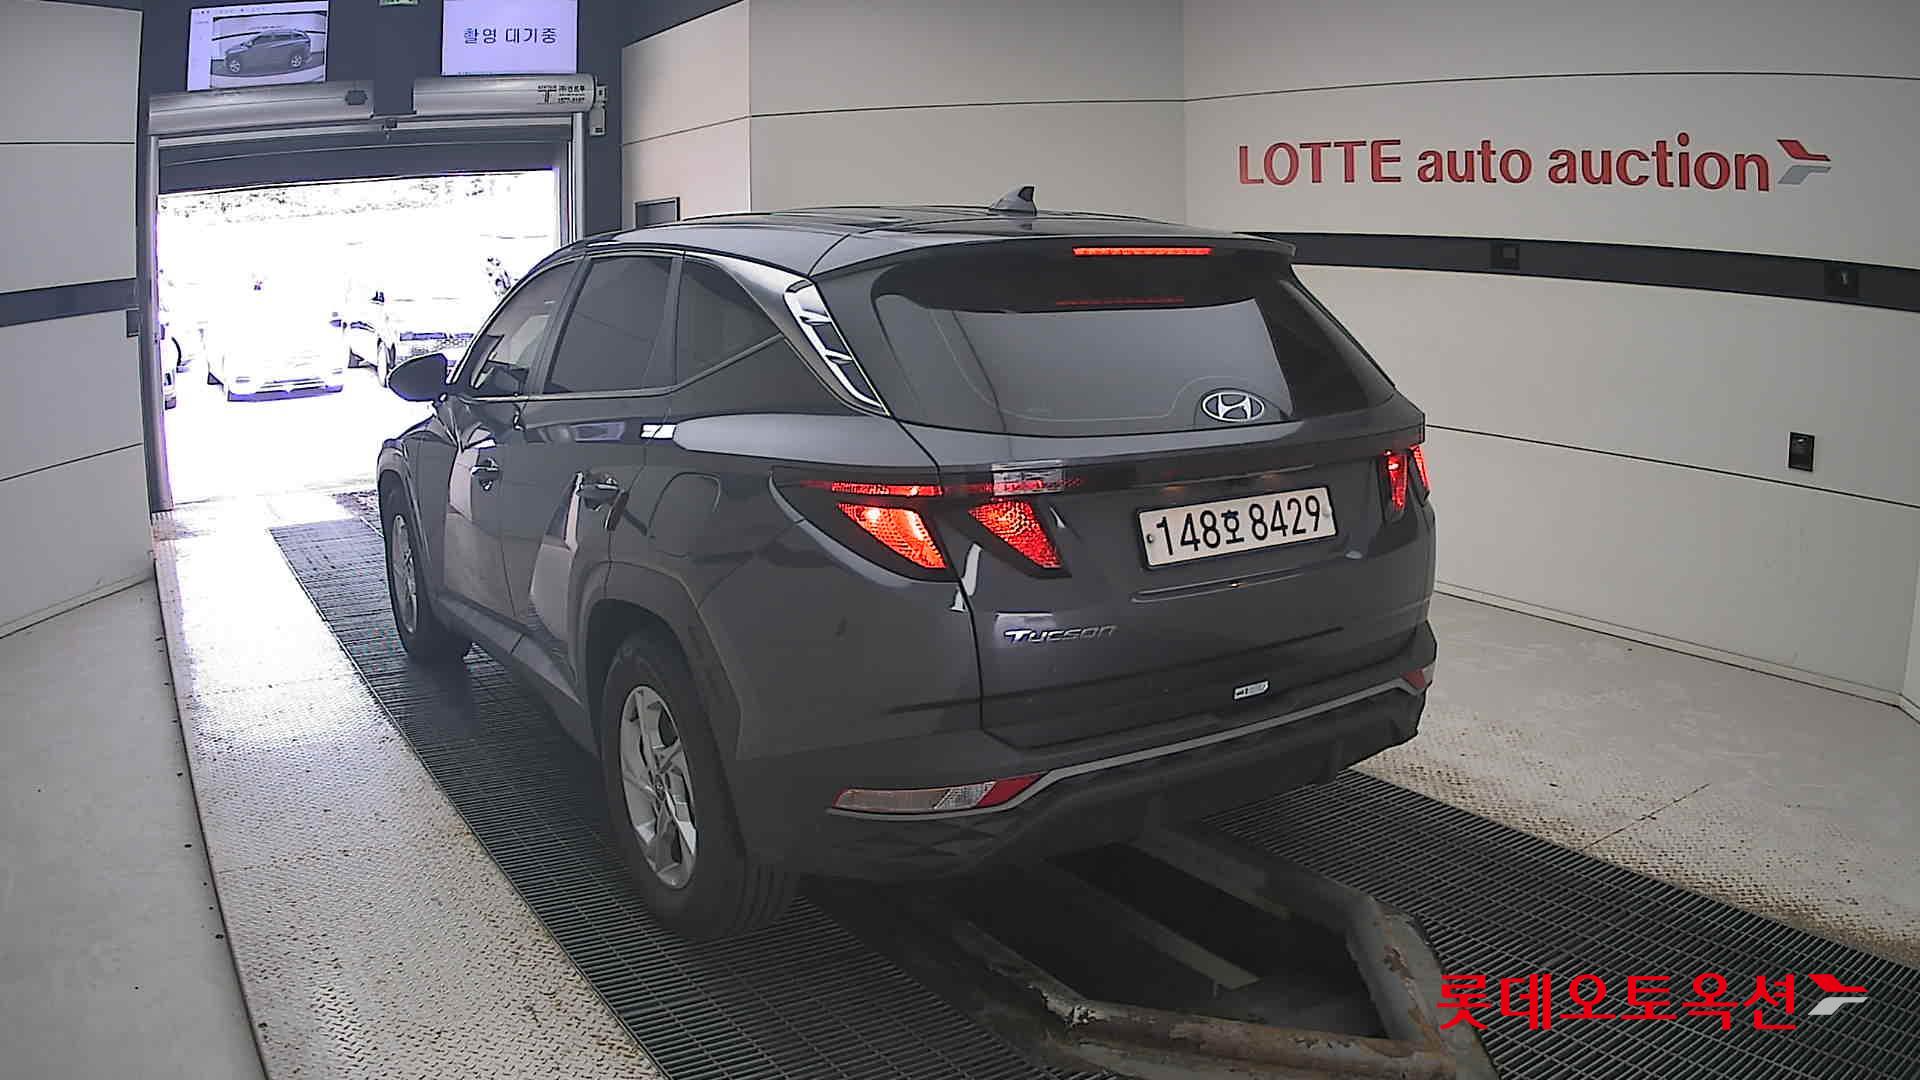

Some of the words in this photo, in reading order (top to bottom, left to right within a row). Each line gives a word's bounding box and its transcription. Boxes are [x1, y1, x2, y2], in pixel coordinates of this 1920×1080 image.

[463, 27, 496, 44] 촬영
[505, 27, 557, 44] 대기중
[1238, 139, 1402, 186] LOTTE
[1416, 139, 1532, 184] auto
[1547, 132, 1770, 191] auction
